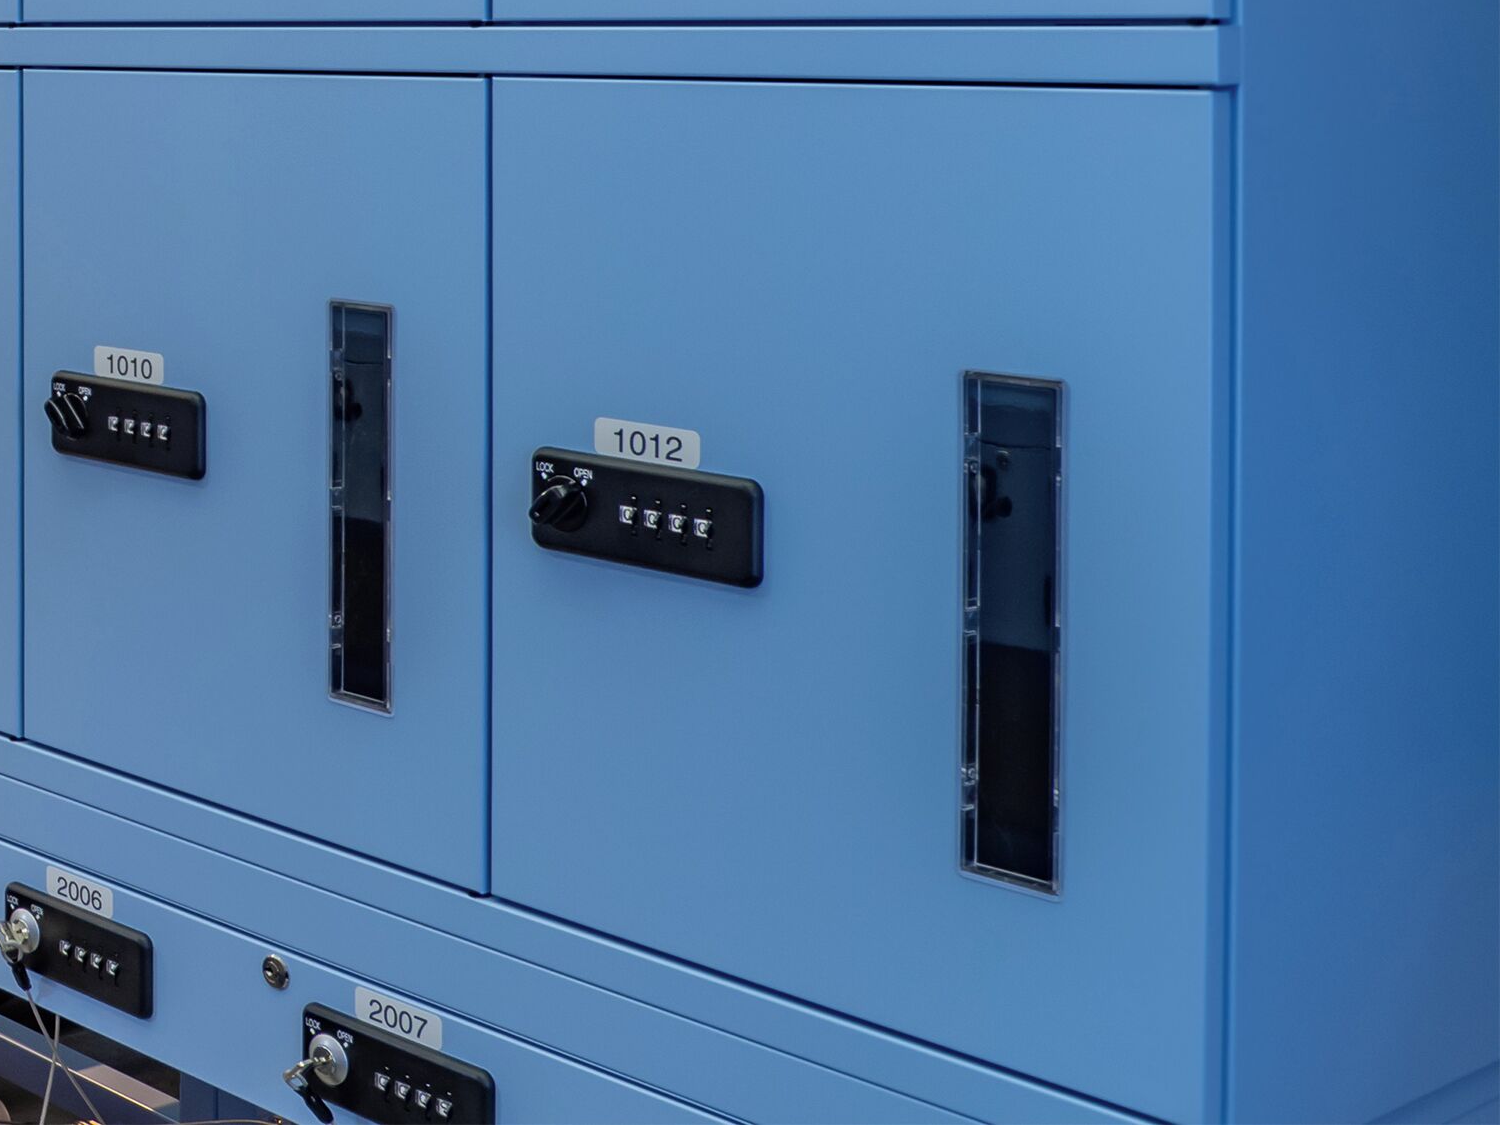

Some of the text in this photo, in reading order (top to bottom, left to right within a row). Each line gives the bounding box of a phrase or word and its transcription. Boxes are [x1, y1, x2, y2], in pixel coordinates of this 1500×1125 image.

[106, 354, 152, 379] 1010
[613, 428, 683, 462] 1012
[535, 461, 554, 473] LOCK
[573, 467, 593, 479] OPEN
[57, 877, 102, 911] 2006
[305, 1017, 321, 1030] LOCK
[369, 999, 428, 1038] 2007
[337, 1029, 353, 1044] OPEN
